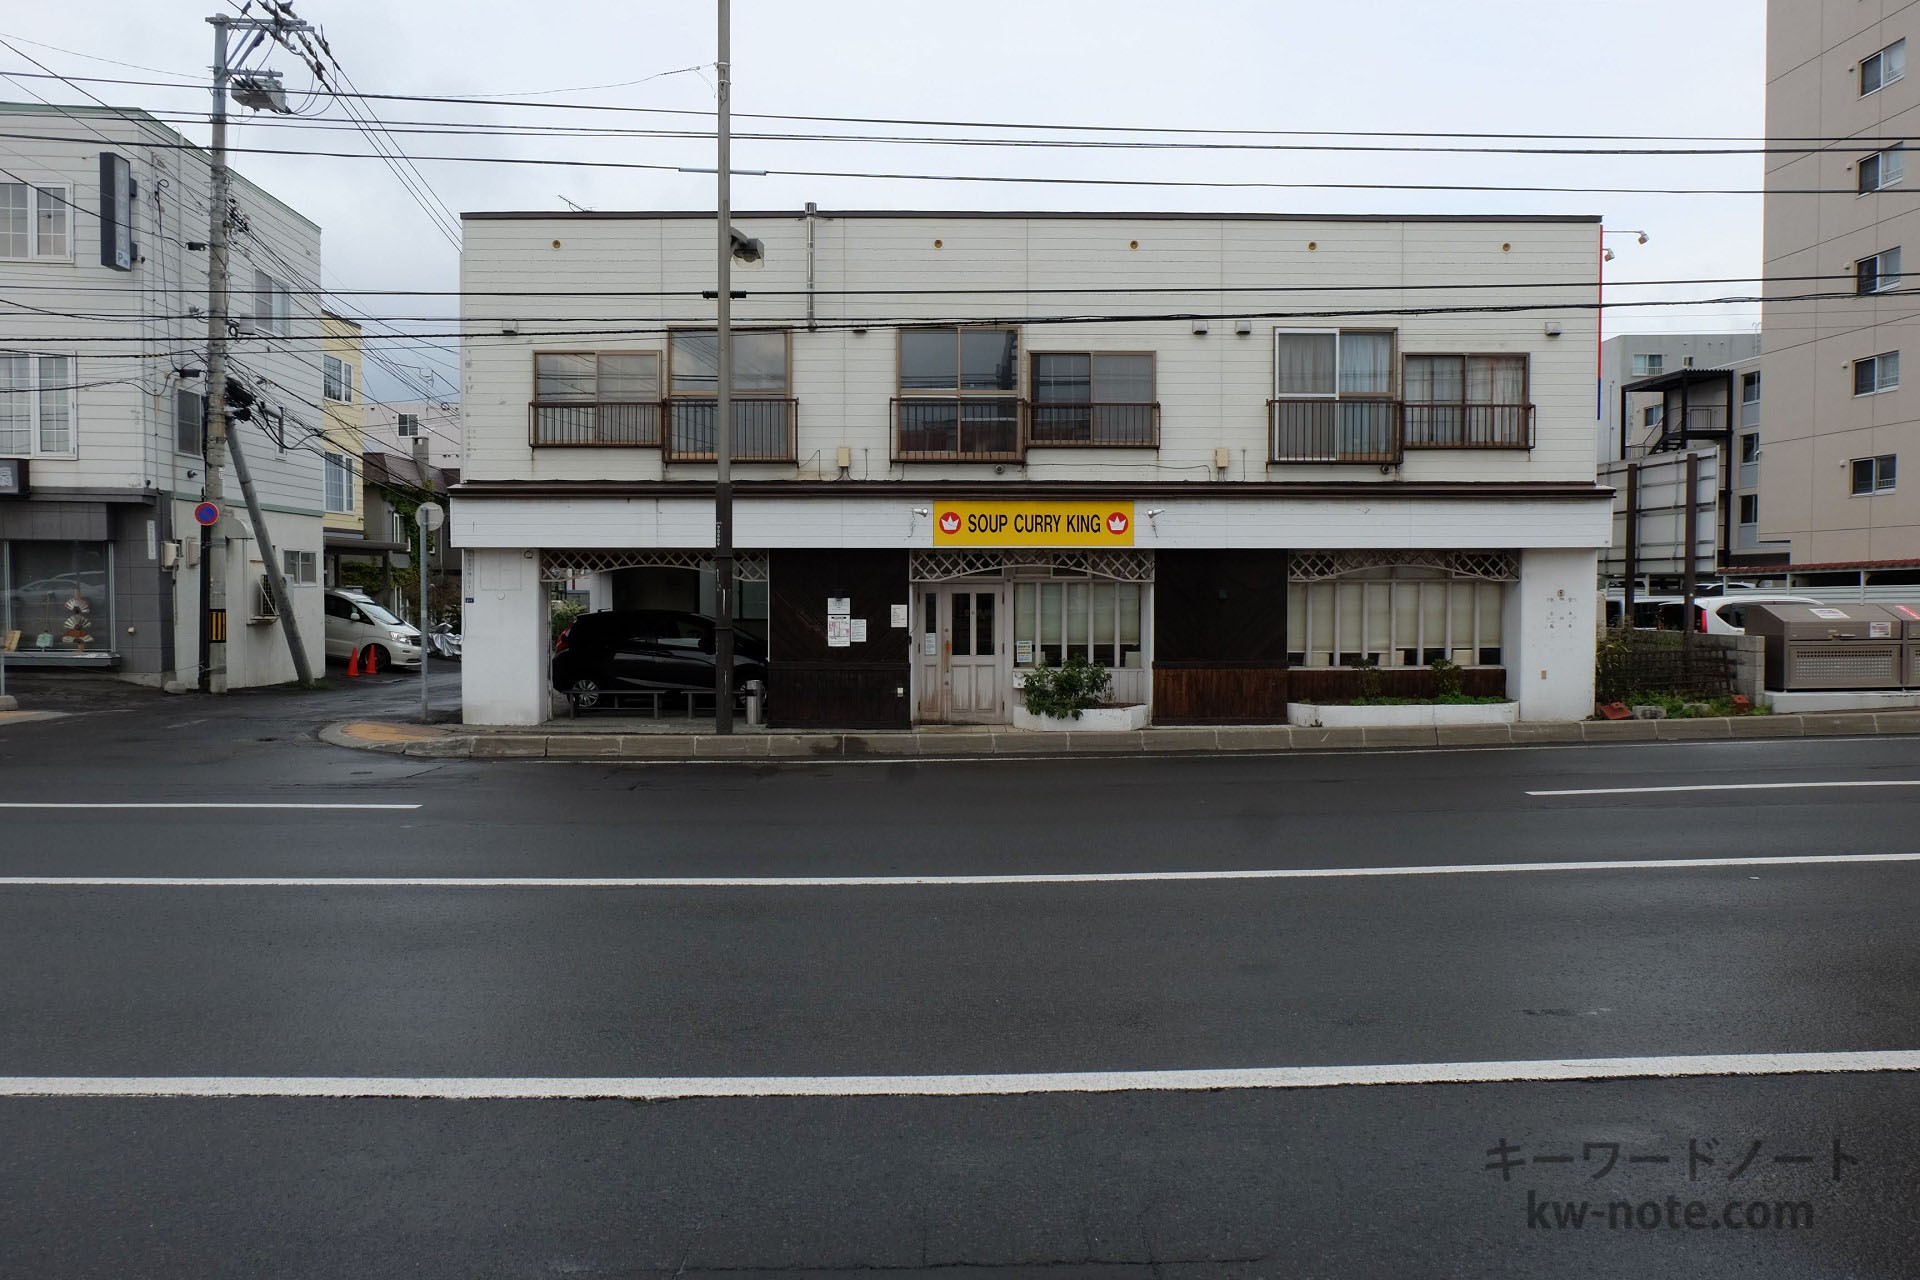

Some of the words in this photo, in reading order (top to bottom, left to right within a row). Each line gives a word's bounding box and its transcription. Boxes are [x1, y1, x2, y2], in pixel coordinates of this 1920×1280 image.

[968, 513, 1008, 533] SOUP
[1014, 513, 1062, 533] CURRY
[1067, 513, 1101, 533] KING
